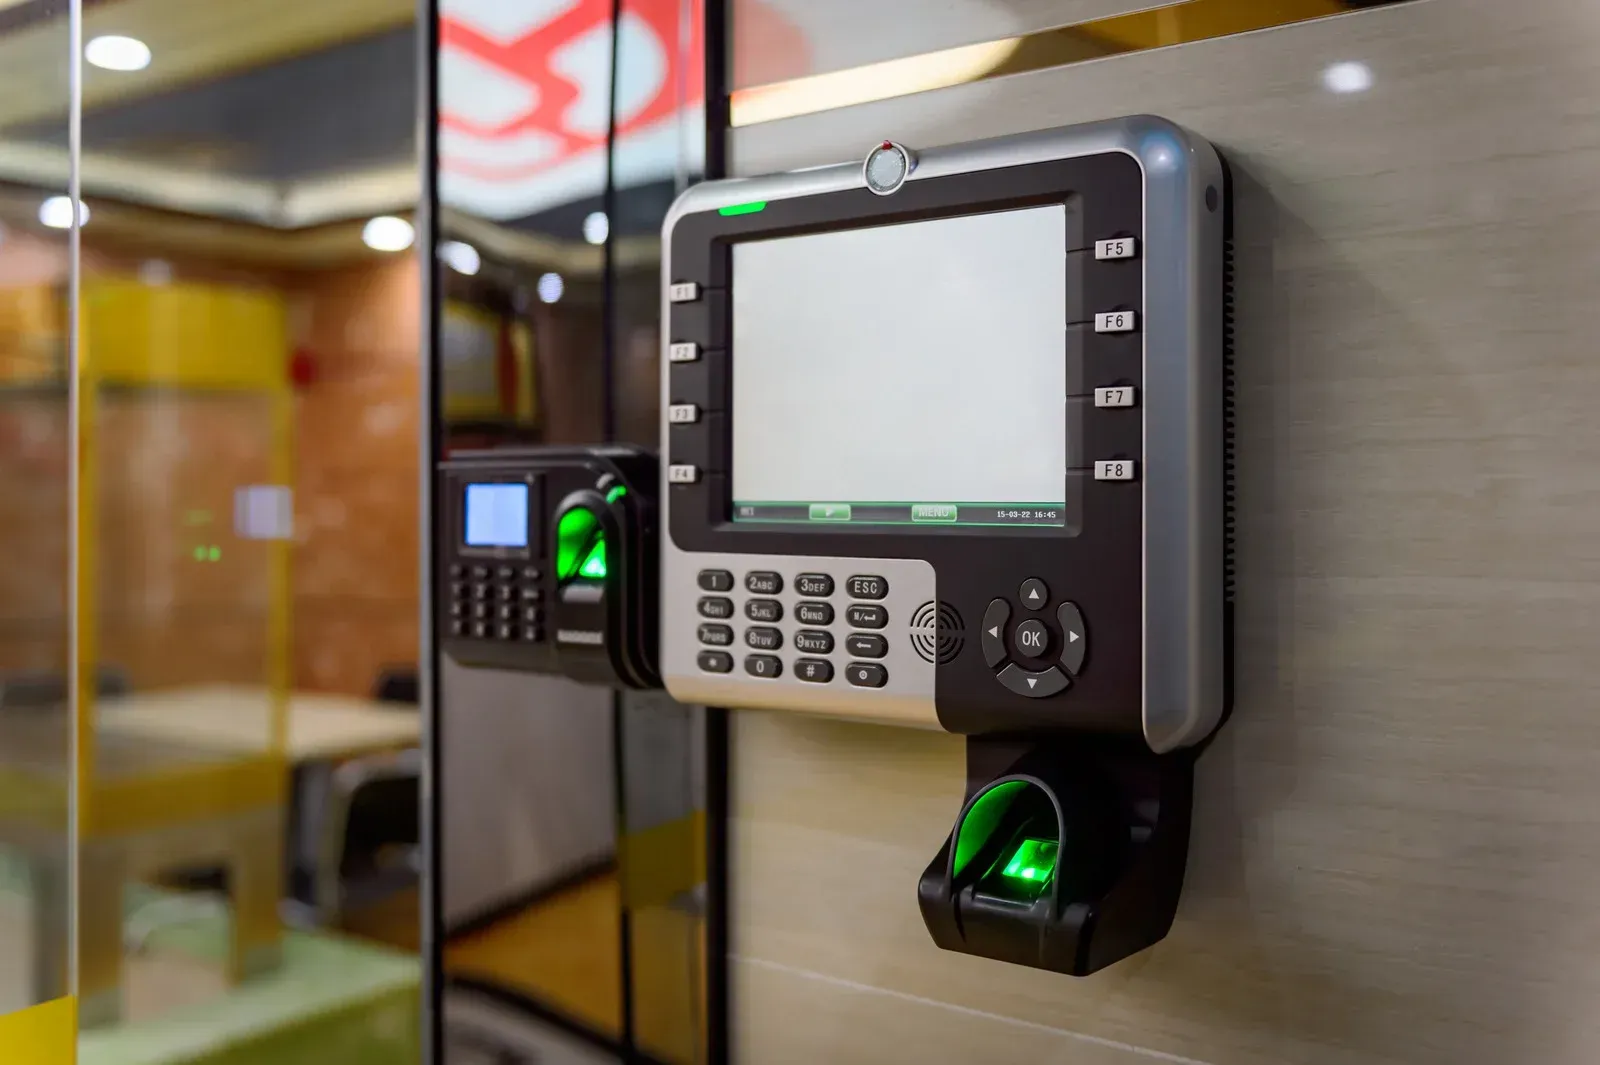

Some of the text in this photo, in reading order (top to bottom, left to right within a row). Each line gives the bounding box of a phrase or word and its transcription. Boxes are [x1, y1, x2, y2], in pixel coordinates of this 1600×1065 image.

[1105, 242, 1124, 256] F5
[676, 286, 689, 298] F1
[1105, 315, 1124, 328] F6
[676, 347, 689, 358] F2
[1105, 390, 1124, 404] F7
[675, 408, 688, 420] F3
[674, 468, 688, 479] F4
[1104, 463, 1124, 477] F8
[918, 507, 950, 517] MENU
[997, 510, 1057, 519] 15-03-22 16:45
[711, 576, 717, 587] 1
[801, 579, 826, 592] 3DEF
[854, 581, 878, 594] ESC
[1022, 630, 1041, 647] OK
